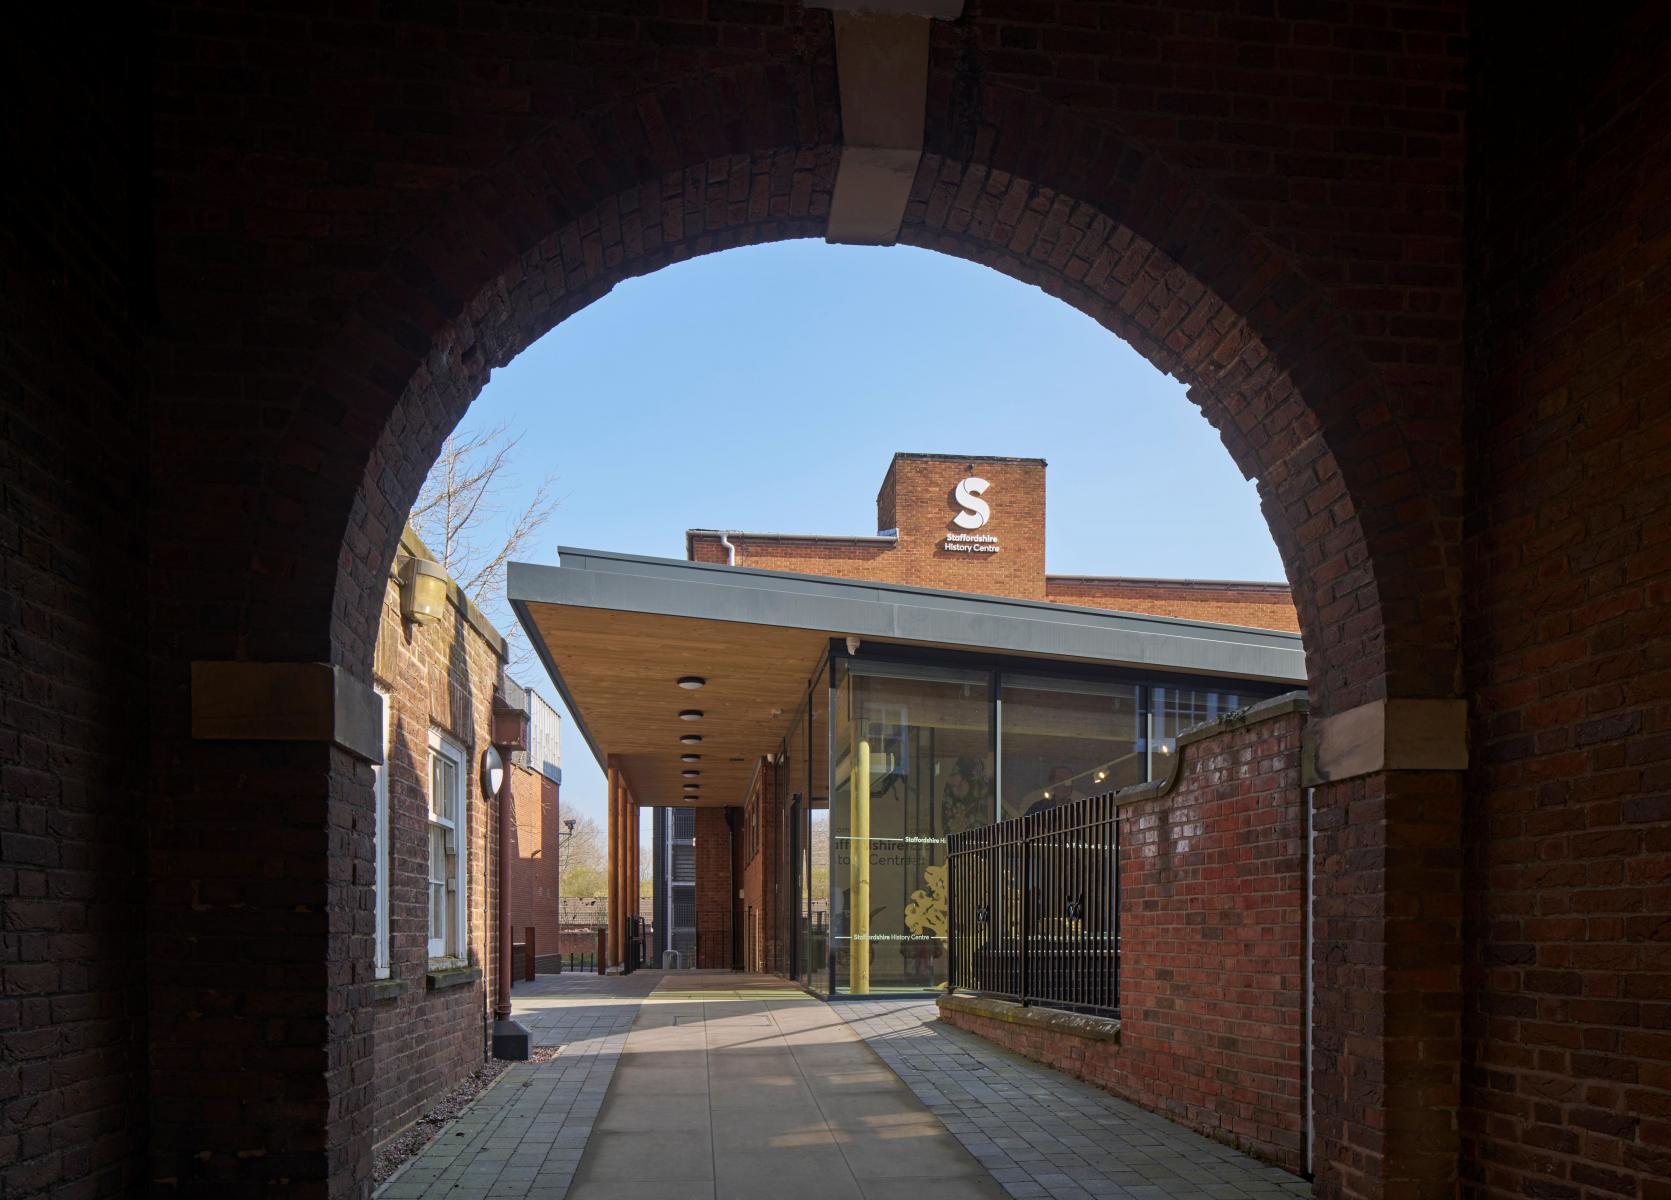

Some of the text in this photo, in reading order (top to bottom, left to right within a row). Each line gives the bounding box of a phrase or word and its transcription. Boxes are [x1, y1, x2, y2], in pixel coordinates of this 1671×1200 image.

[954, 477, 990, 529] S
[947, 534, 997, 543] Staffordshire
[945, 543, 1000, 553] History Centre
[905, 836, 940, 844] Staffordshire
